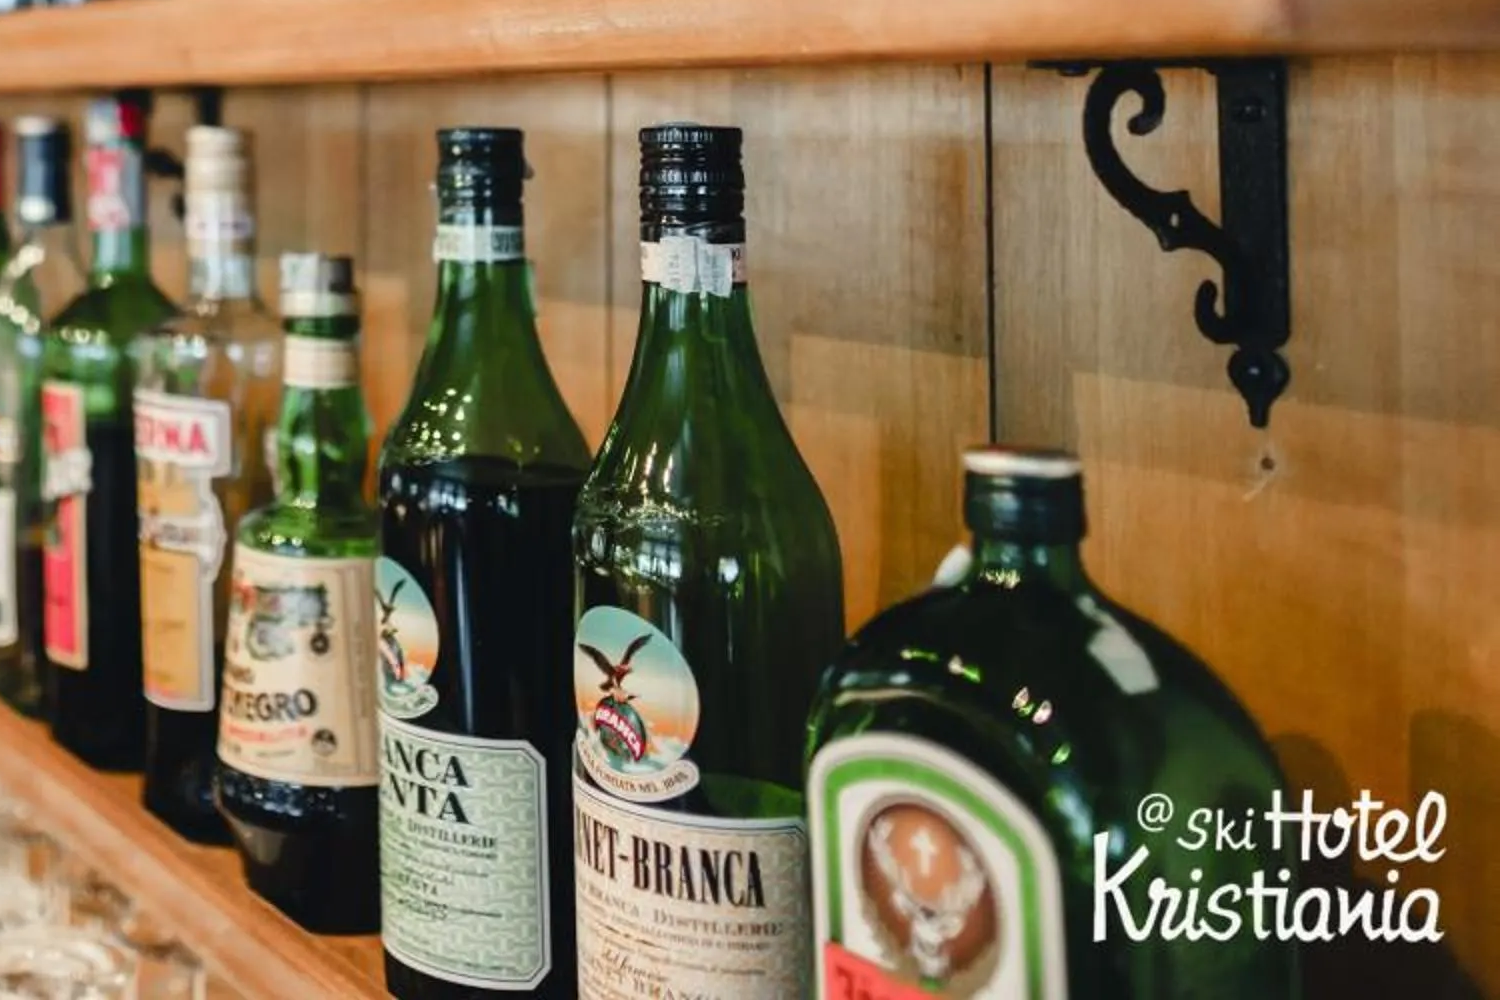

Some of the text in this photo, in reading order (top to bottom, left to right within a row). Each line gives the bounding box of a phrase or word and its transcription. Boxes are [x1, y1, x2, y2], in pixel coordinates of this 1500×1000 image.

[594, 706, 642, 759] BRANCA
[380, 771, 472, 825] NTA
[576, 808, 767, 910] NET-BRANCA
